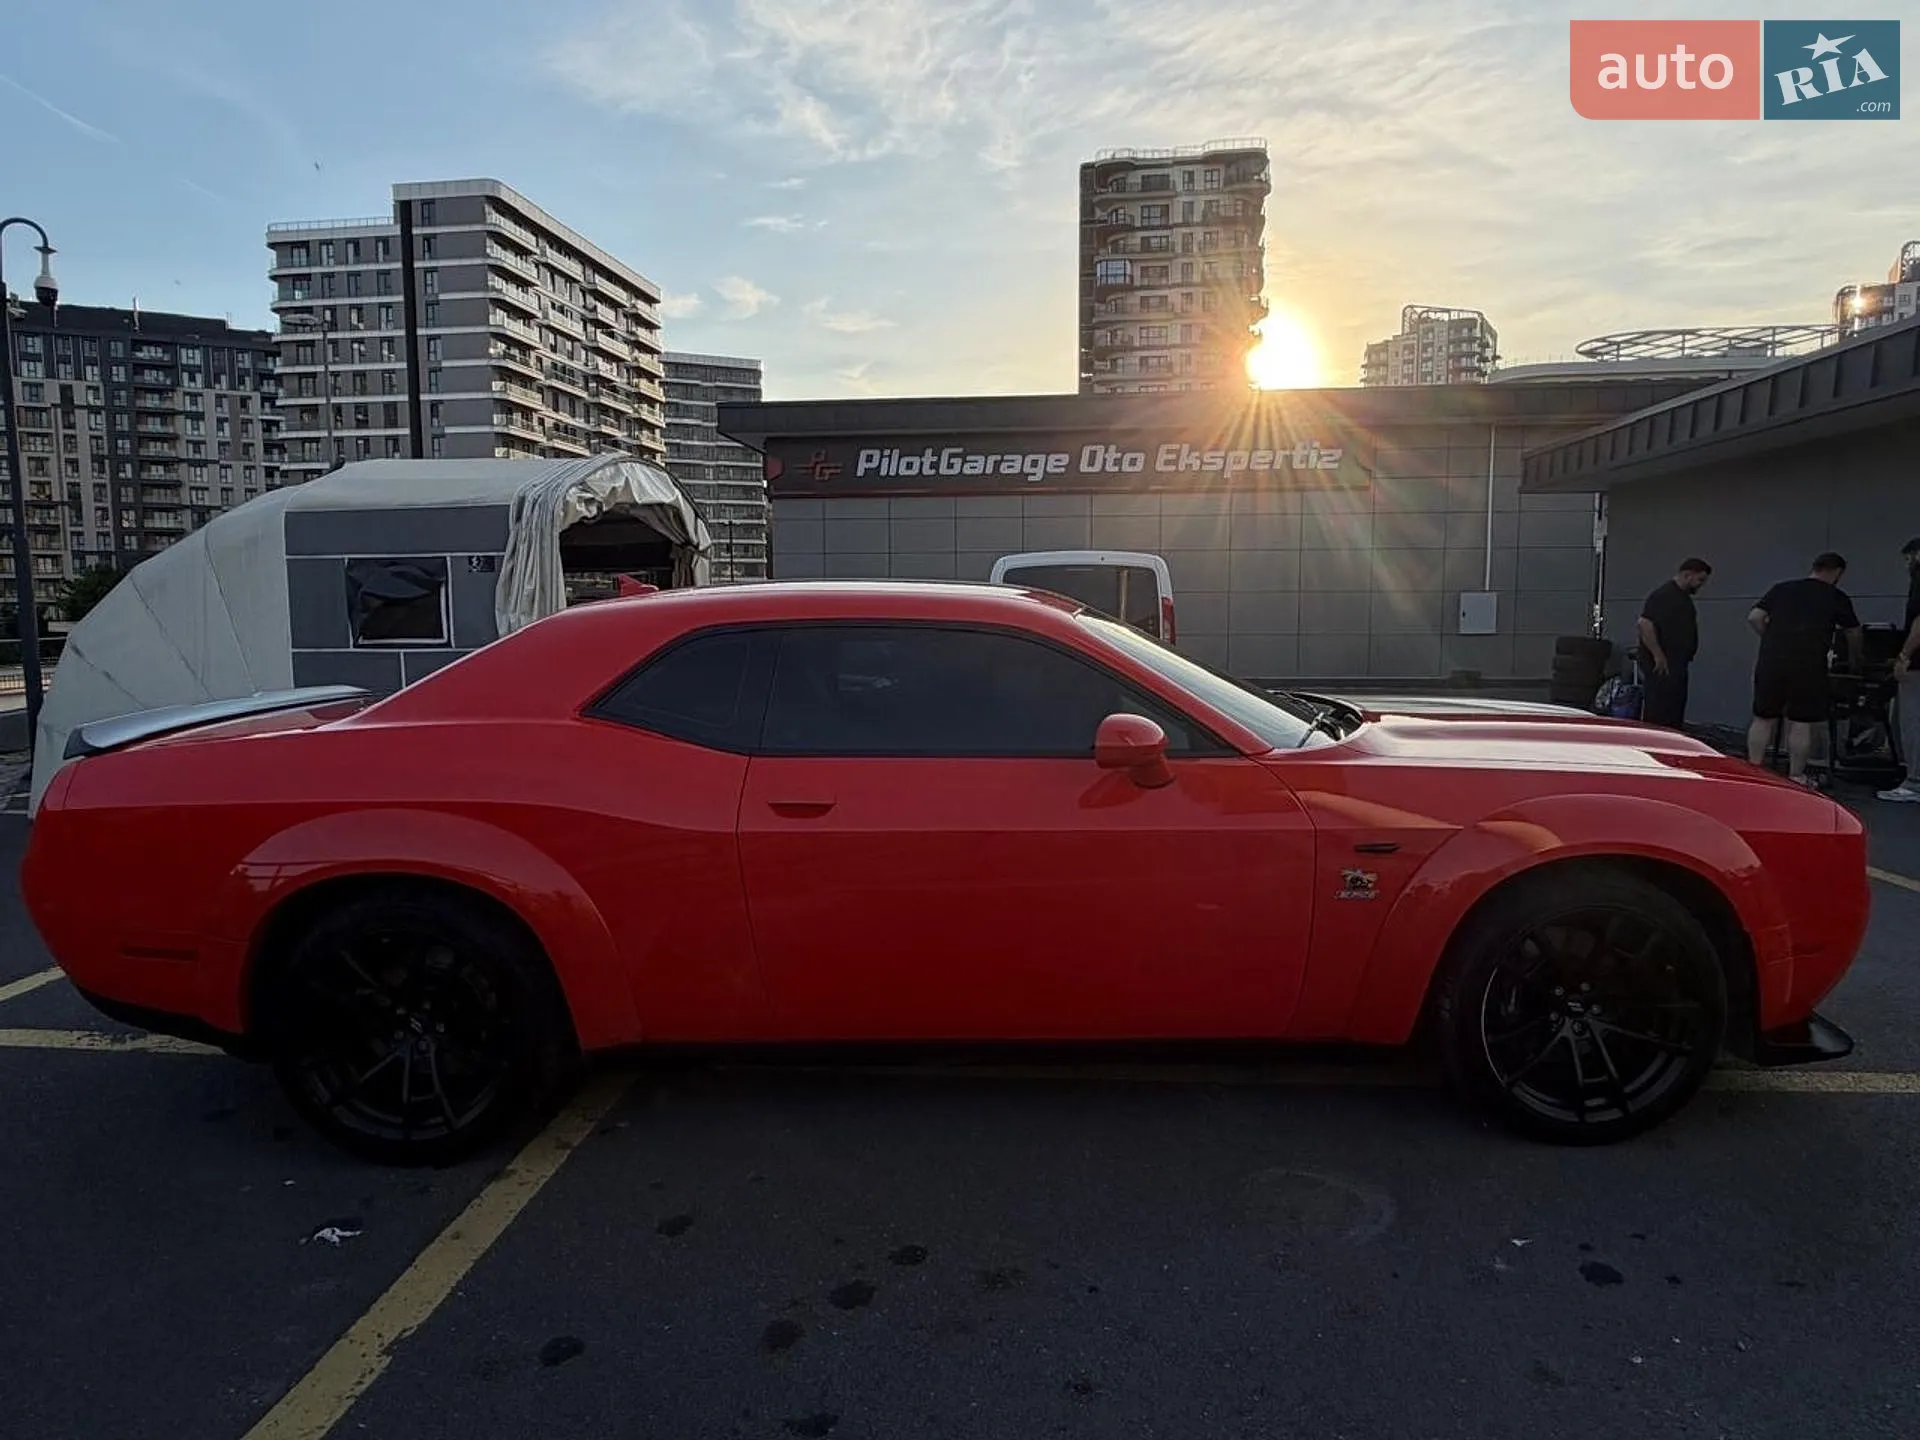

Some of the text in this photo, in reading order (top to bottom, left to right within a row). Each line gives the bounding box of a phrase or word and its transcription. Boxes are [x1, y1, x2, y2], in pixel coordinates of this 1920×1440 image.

[857, 442, 1343, 481] PilotGarage Oto Ekspertiz
